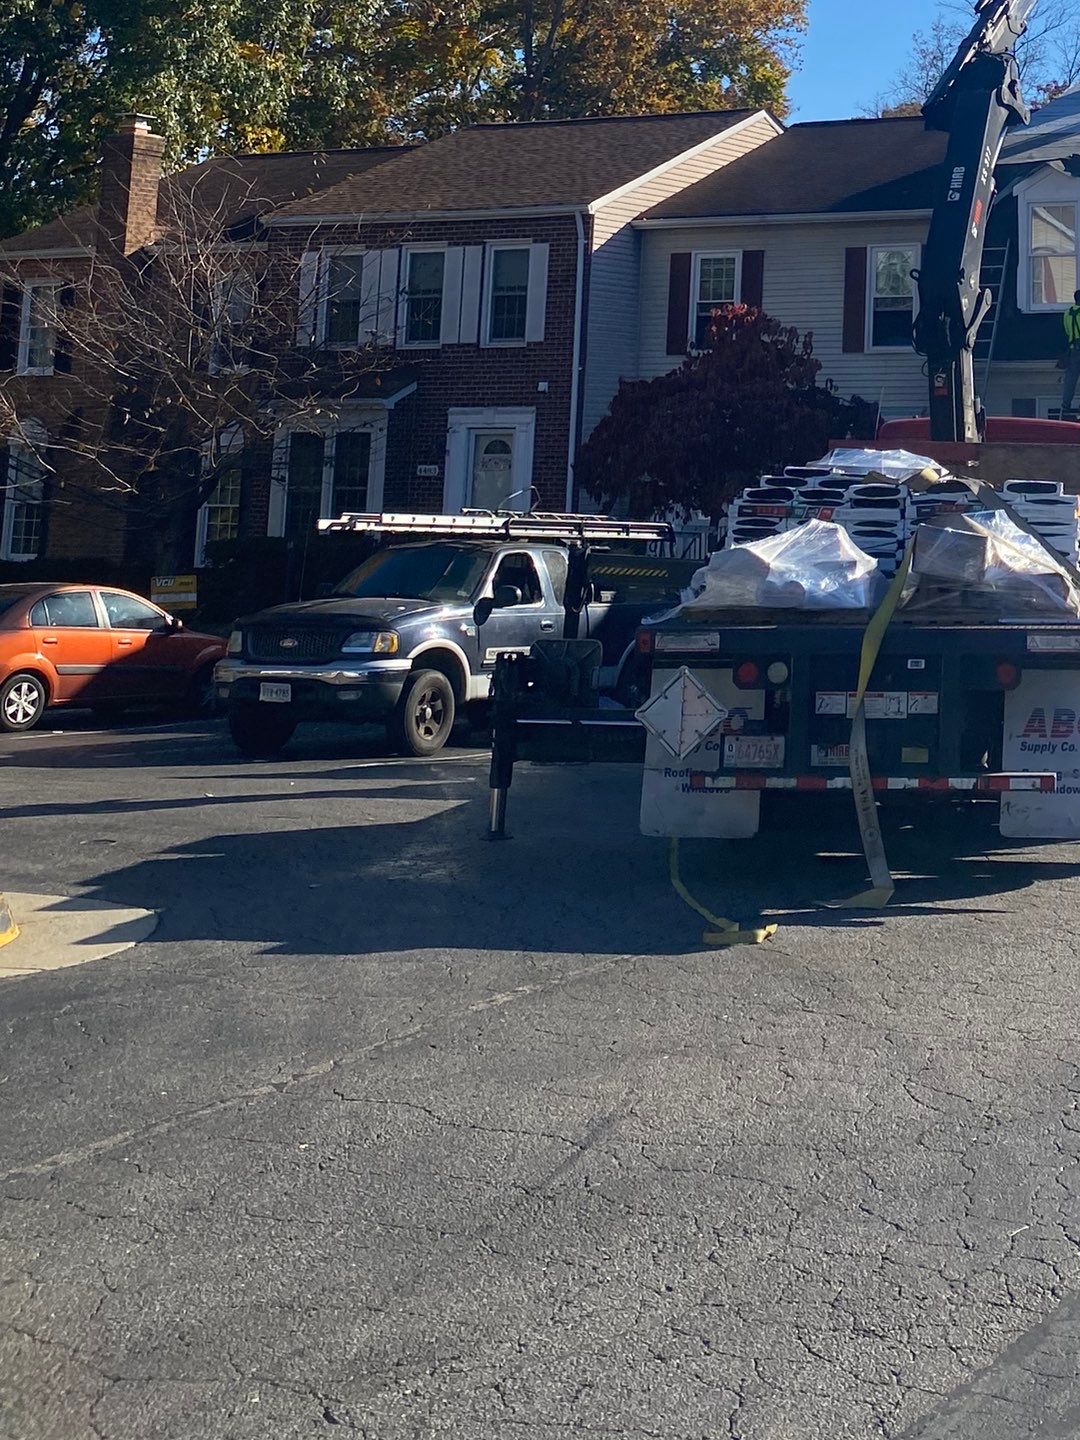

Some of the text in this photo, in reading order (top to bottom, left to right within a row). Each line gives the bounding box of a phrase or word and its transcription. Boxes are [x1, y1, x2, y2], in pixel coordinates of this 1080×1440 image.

[950, 166, 966, 189] HIAB
[1020, 741, 1058, 754] Supply
[1061, 741, 1078, 752] Co.
